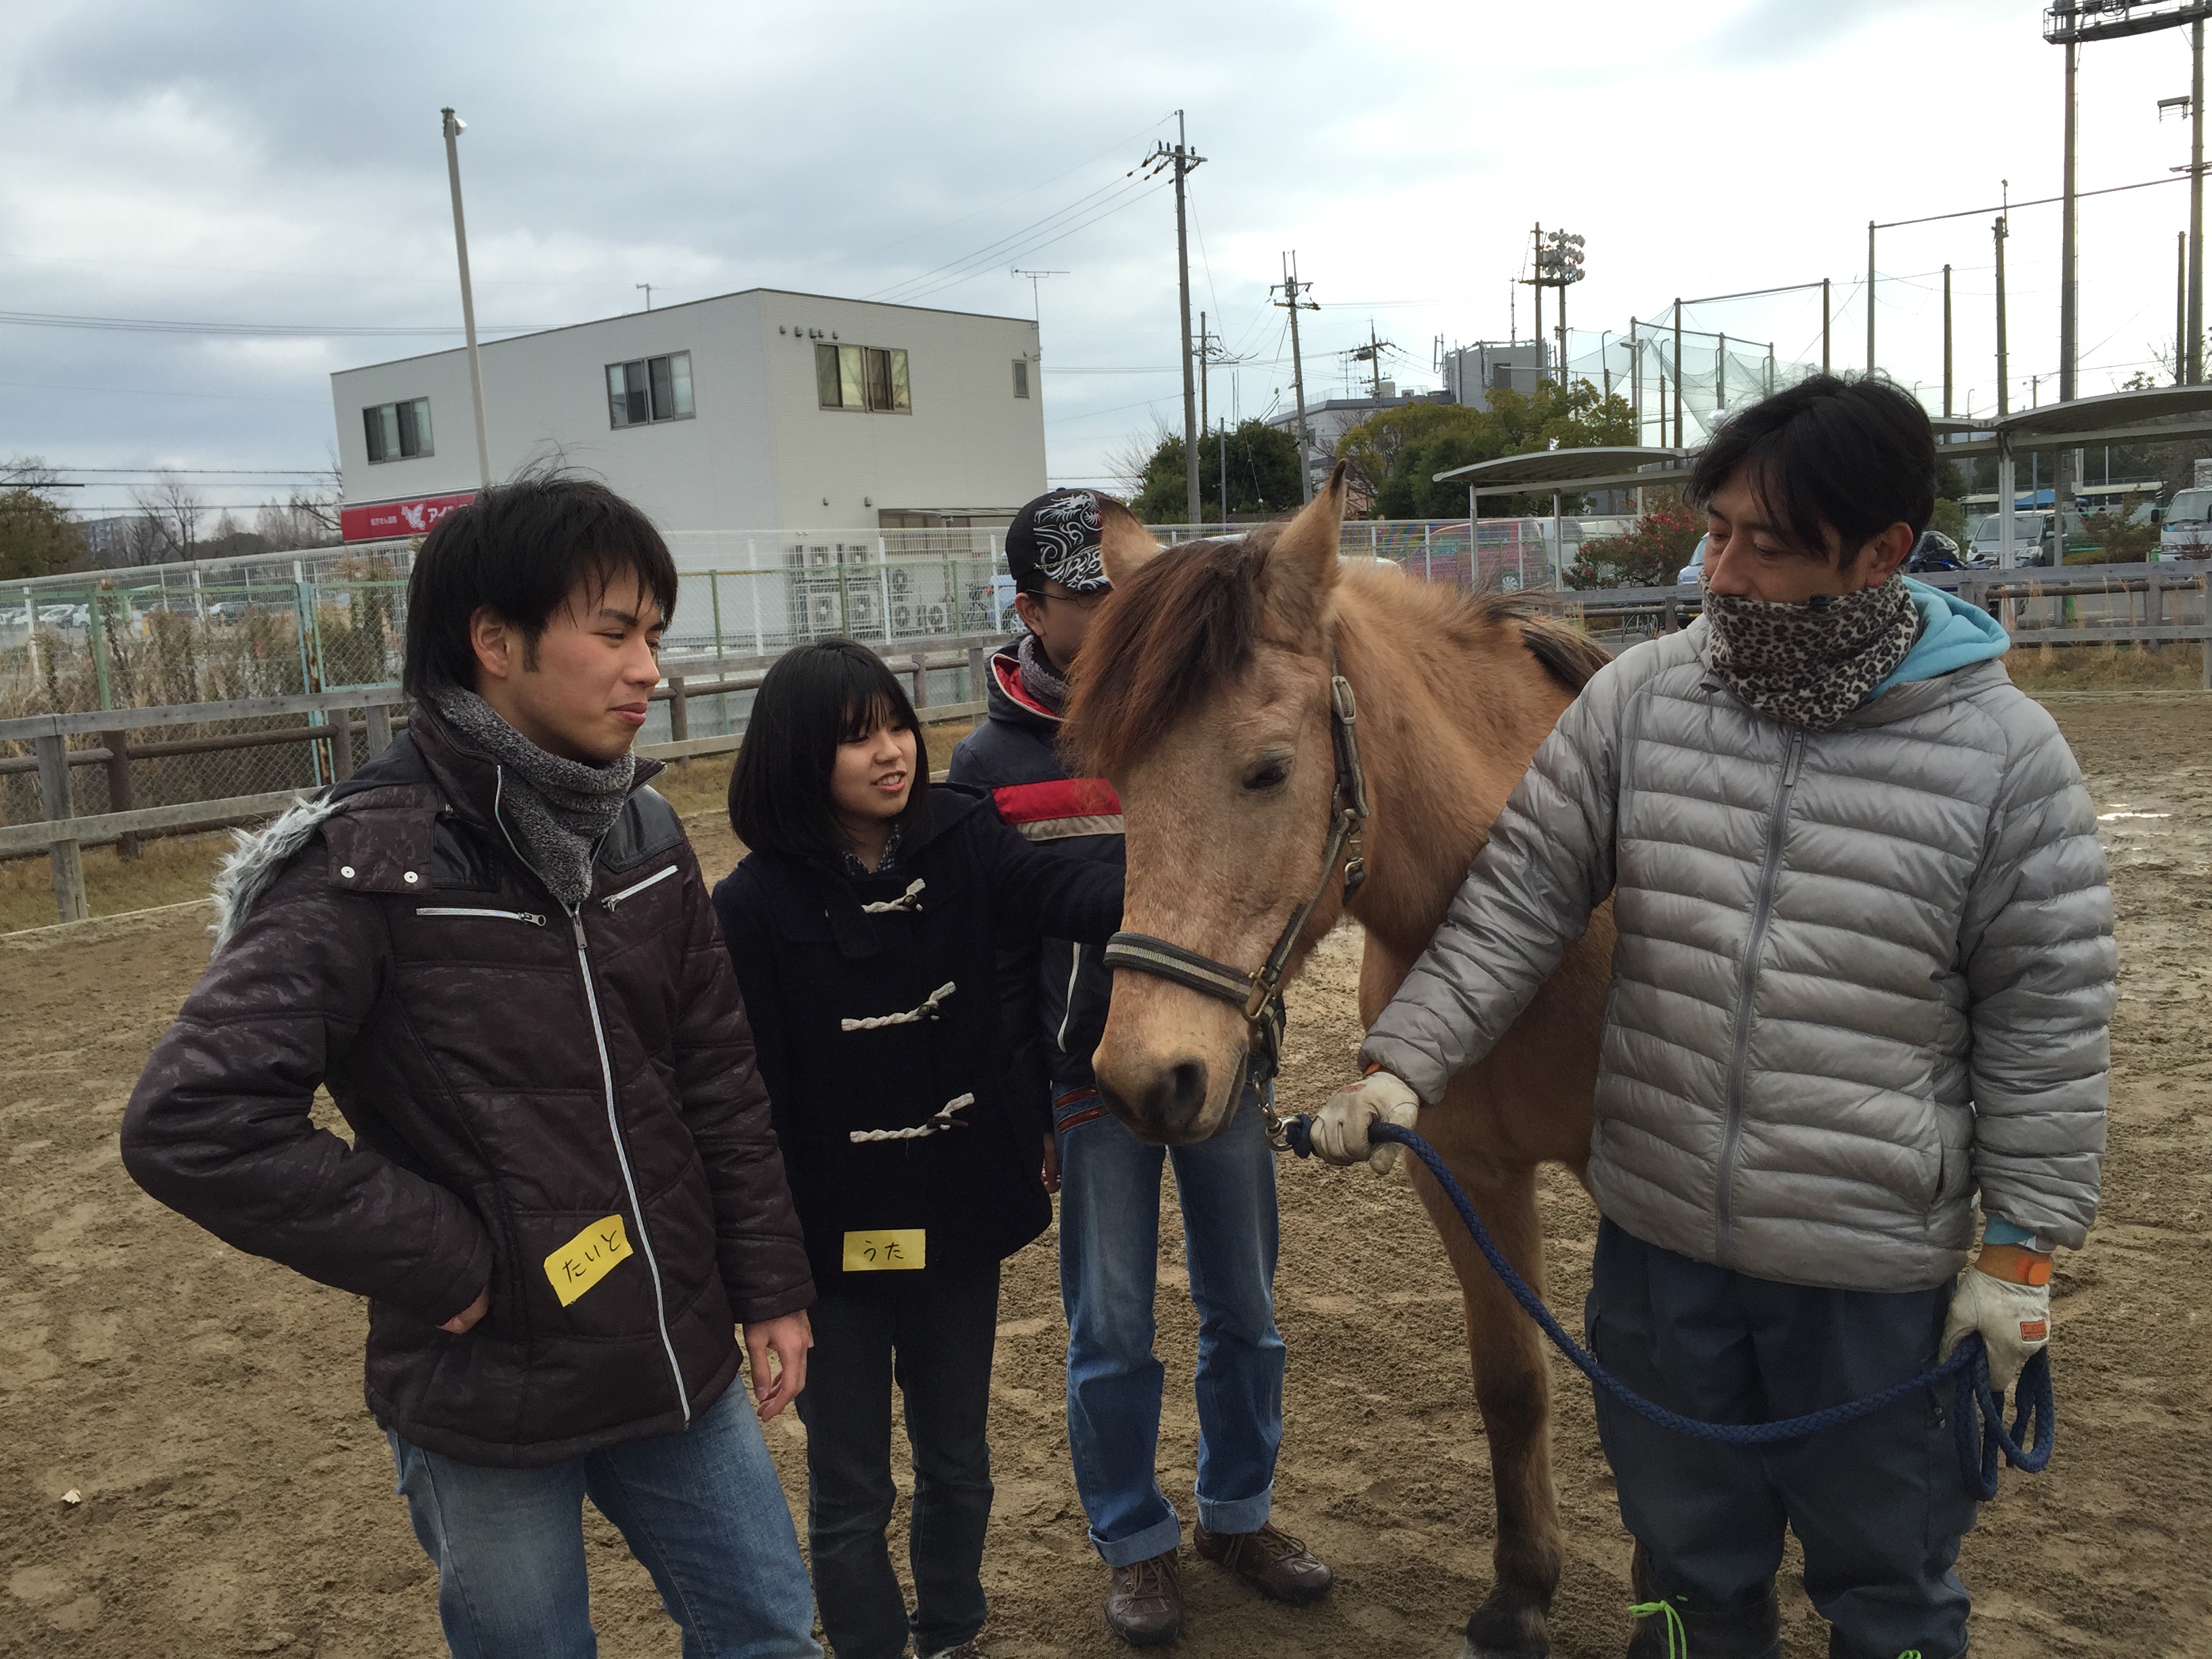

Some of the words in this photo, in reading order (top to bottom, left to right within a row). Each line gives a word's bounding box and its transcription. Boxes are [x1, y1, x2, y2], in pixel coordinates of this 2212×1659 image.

[562, 1230, 621, 1283] たいと
[863, 1240, 904, 1262] うた
